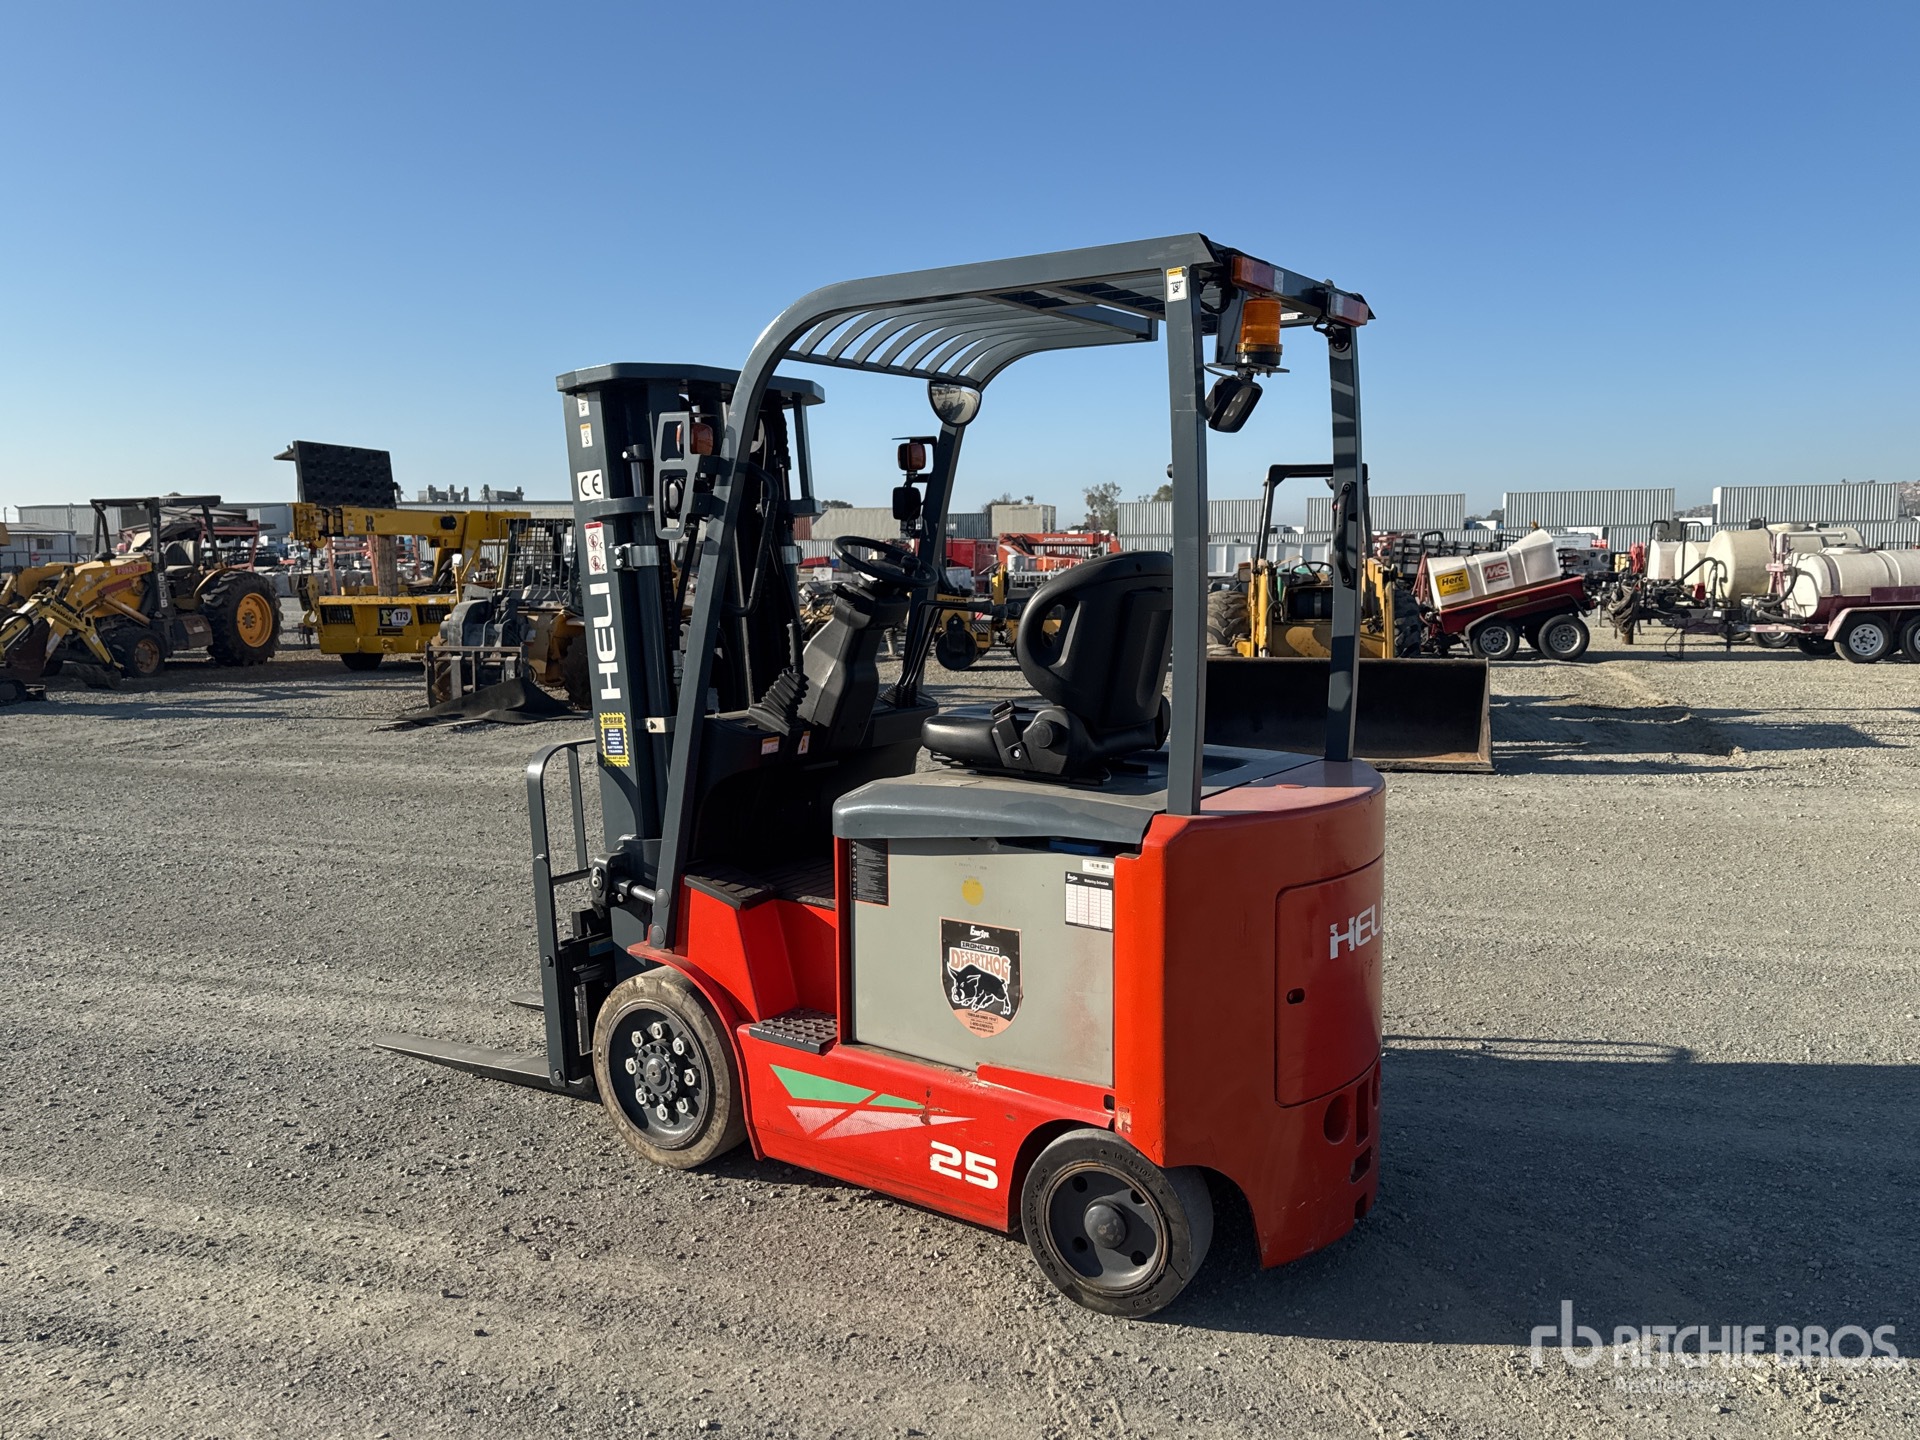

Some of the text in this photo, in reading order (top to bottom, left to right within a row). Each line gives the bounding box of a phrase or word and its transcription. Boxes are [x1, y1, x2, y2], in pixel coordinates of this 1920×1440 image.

[580, 473, 602, 497] CE
[1485, 562, 1510, 578] MQ
[1441, 575, 1464, 587] Herc
[49, 605, 73, 623] YANMAR
[394, 611, 409, 621] 173
[589, 582, 621, 699] HELI
[1329, 896, 1383, 960] HEL
[961, 941, 999, 954] IRONCLAD
[949, 948, 1011, 984] DESERTHOG
[930, 1140, 999, 1190] 25
